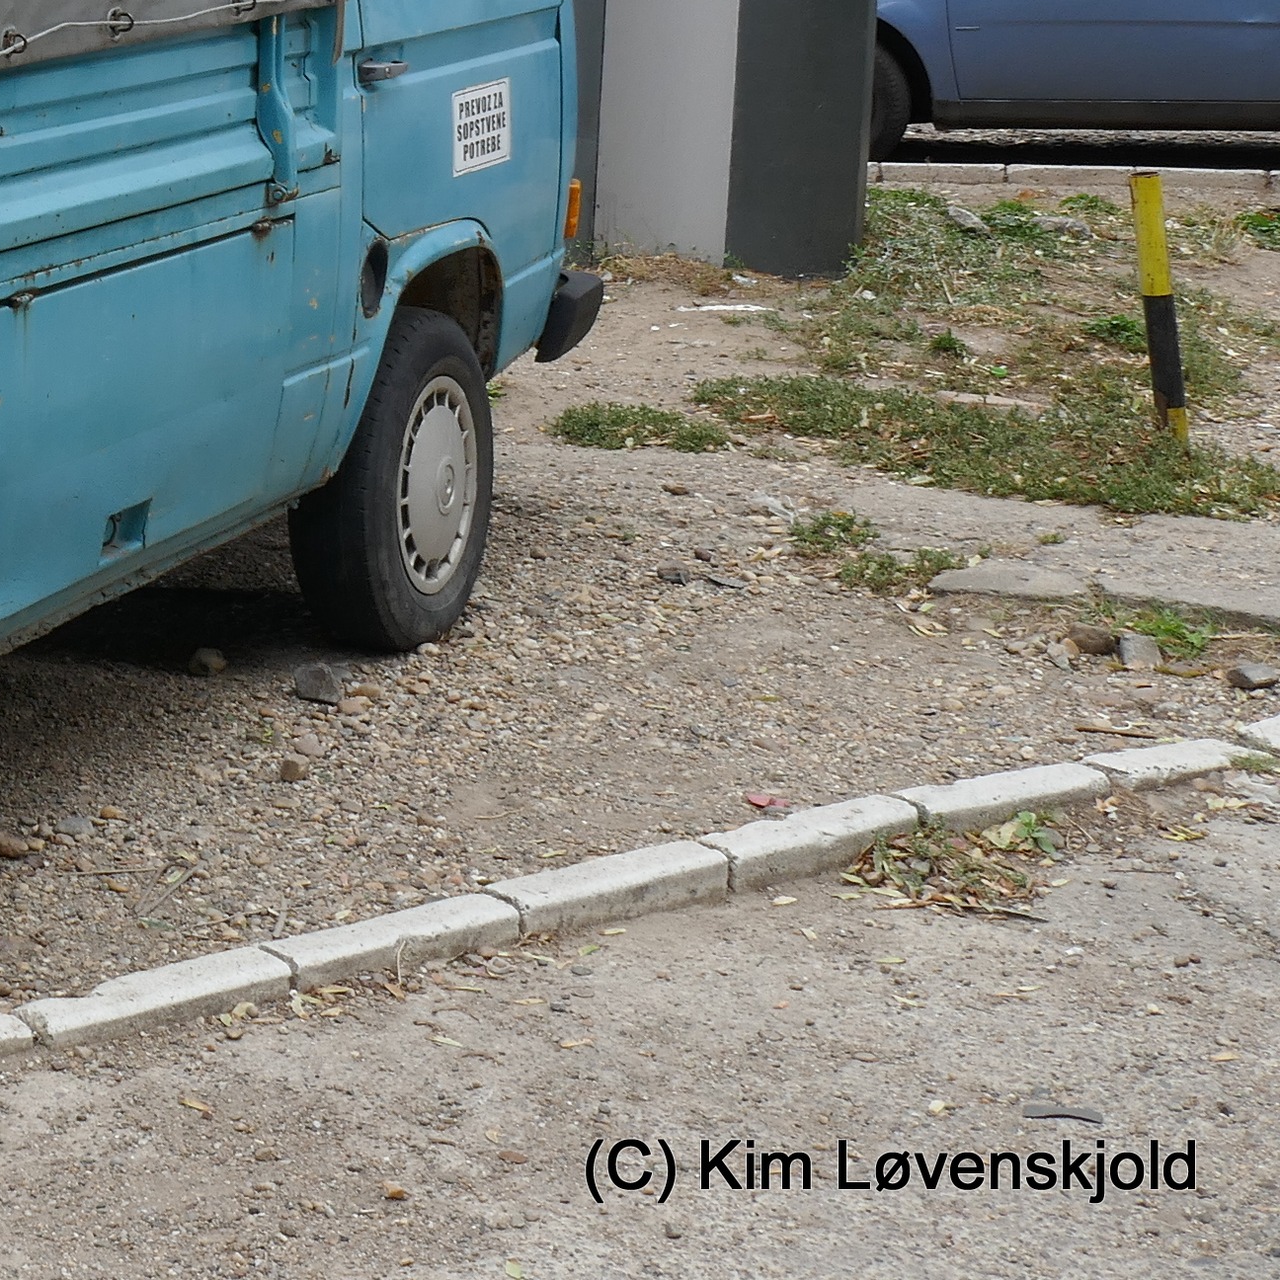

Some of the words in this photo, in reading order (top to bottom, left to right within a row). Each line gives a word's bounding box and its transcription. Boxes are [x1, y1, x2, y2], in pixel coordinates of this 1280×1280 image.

[459, 94, 491, 120] PREVOZ
[493, 91, 503, 110] ZA
[457, 111, 506, 142] SOPSTVENE
[463, 134, 501, 161] POTREBE
